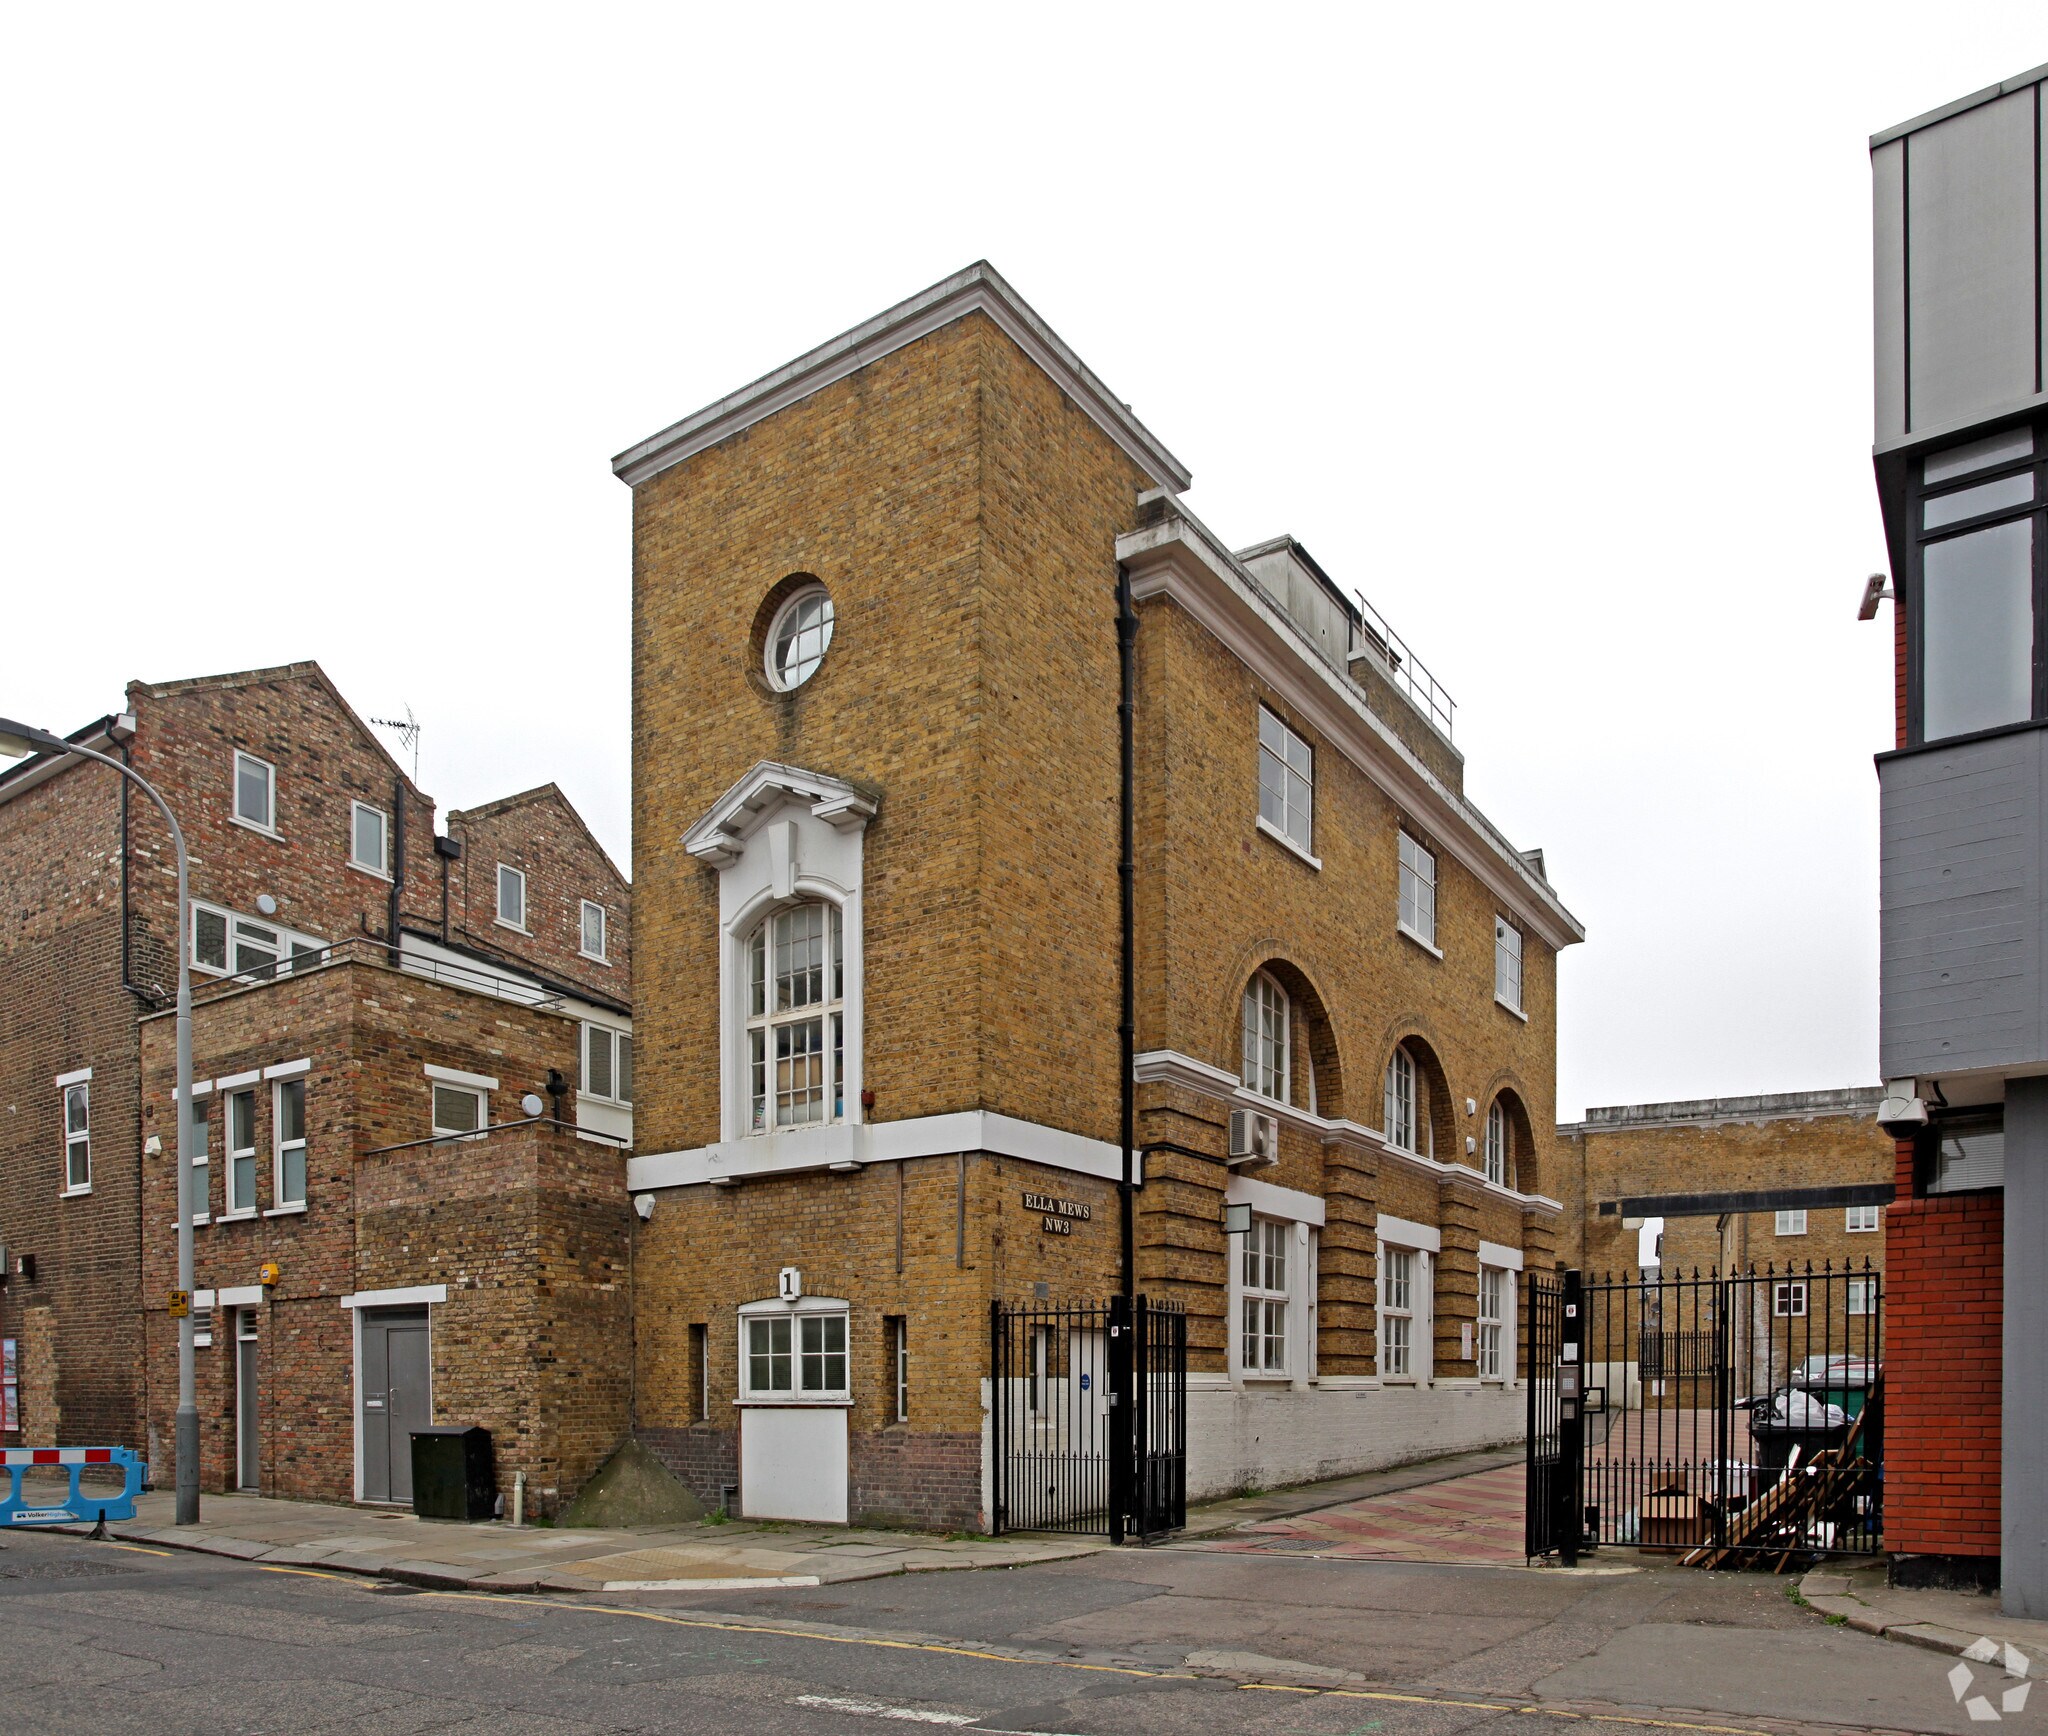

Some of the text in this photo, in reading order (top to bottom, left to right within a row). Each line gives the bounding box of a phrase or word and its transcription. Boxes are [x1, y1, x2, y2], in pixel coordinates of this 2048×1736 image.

[1025, 1194, 1090, 1219] ELLA MEWS
[1045, 1217, 1070, 1234] NW3
[784, 1272, 793, 1295] 1
